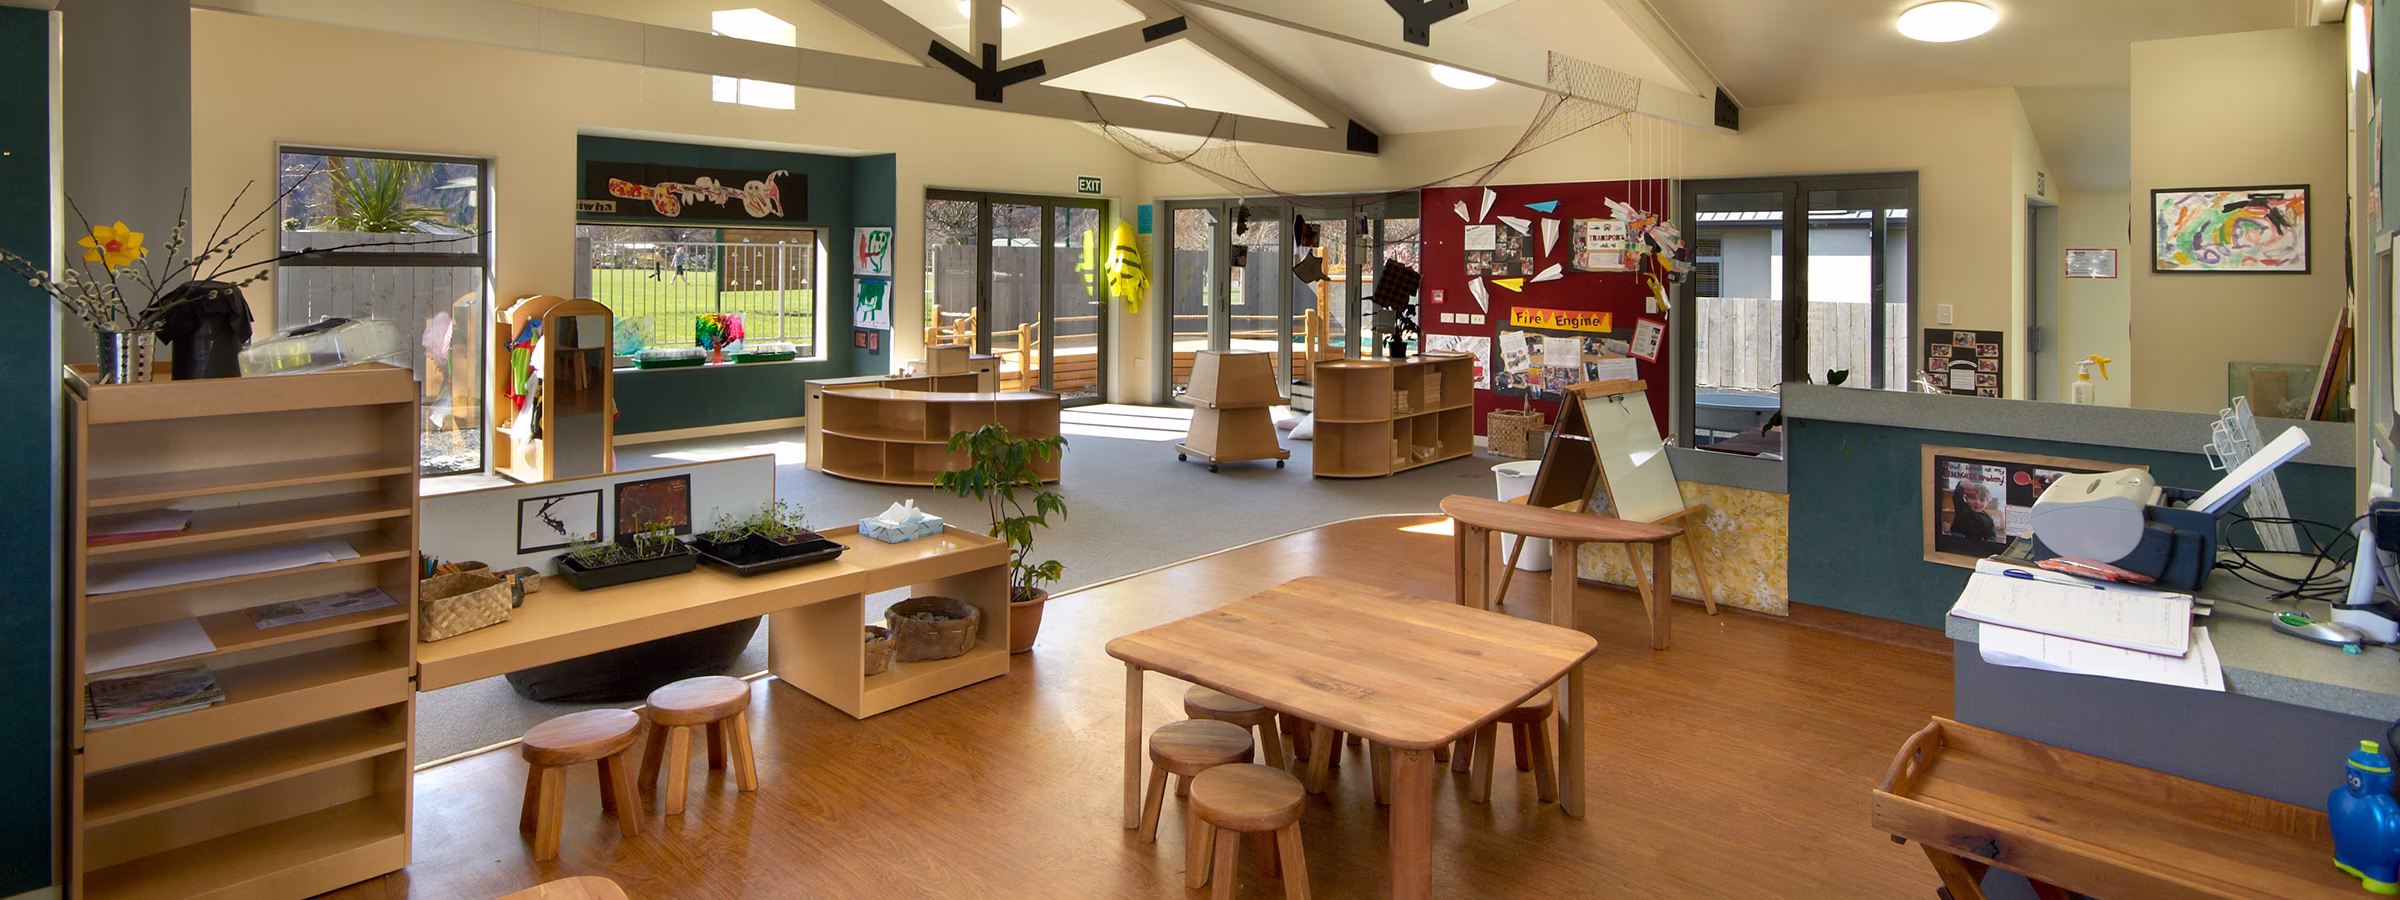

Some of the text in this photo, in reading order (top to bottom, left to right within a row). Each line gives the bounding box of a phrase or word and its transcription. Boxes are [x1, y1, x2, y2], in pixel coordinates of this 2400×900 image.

[1079, 179, 1100, 191] EXIT
[1516, 312, 1600, 328] Fire Engine
[1994, 468, 2005, 476] my
